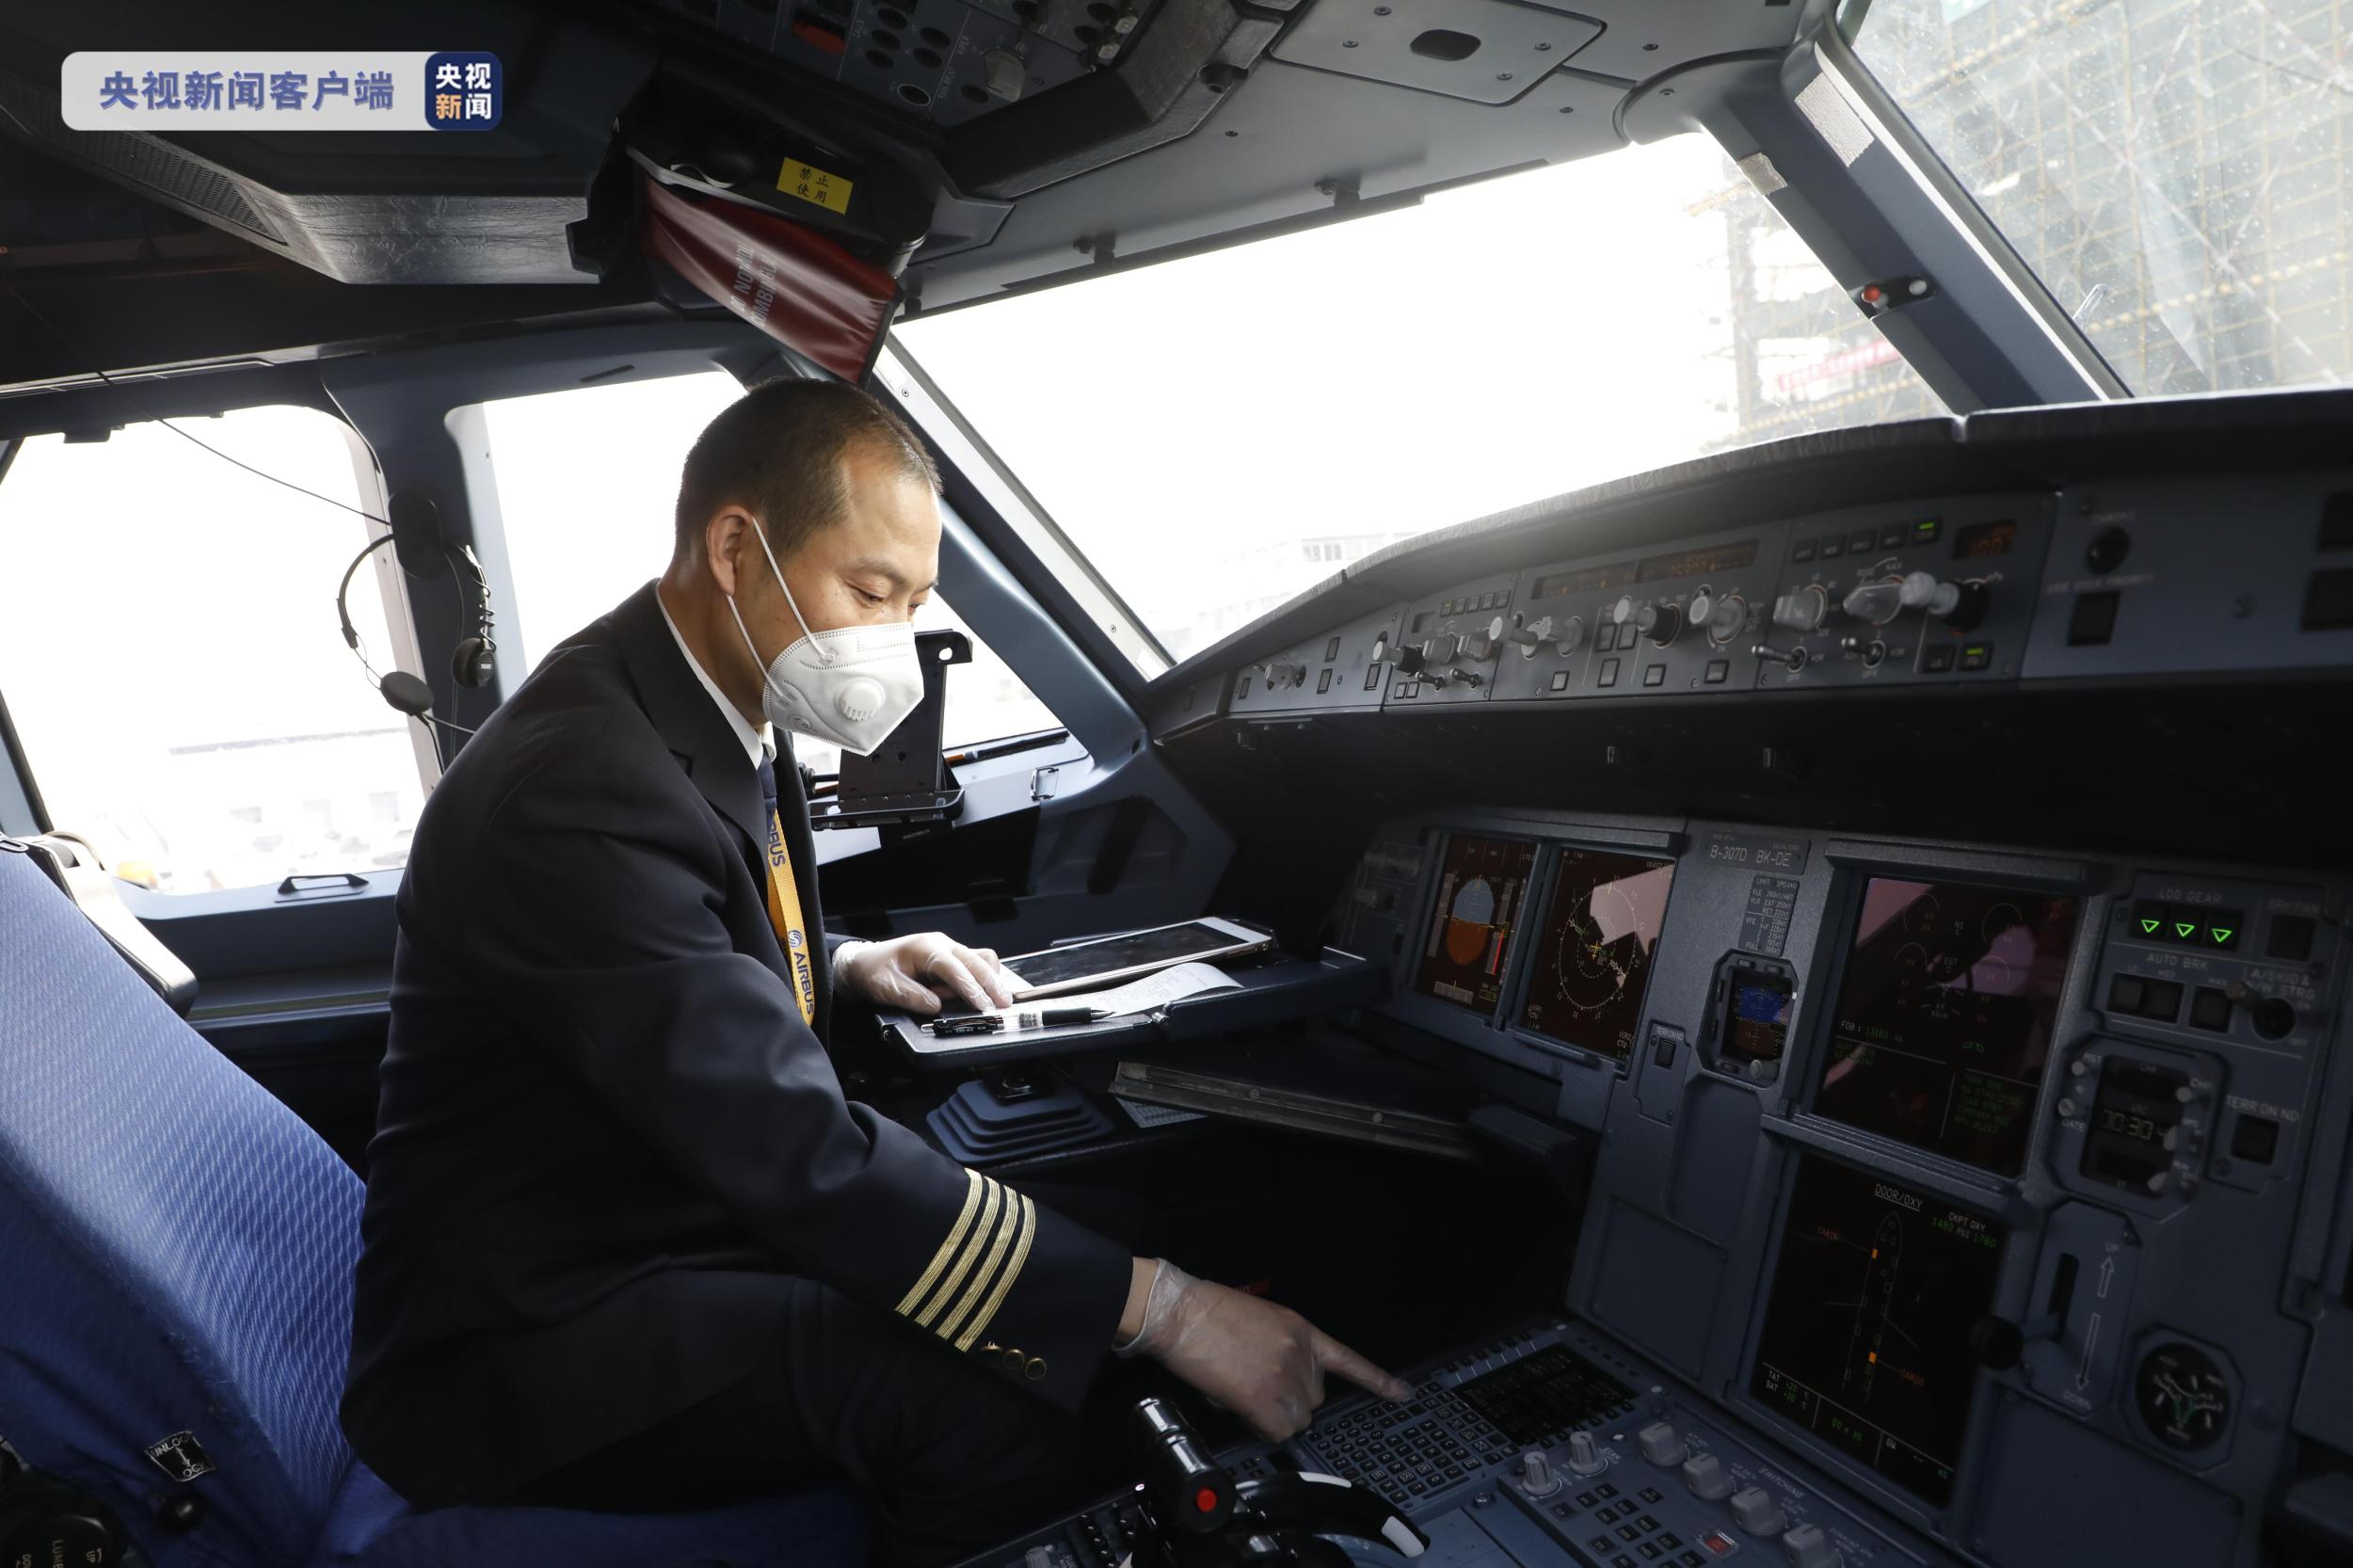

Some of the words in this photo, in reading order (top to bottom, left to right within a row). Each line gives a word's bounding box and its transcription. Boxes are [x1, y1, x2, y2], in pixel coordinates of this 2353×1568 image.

[800, 167, 829, 187] 禁止
[797, 183, 828, 203] 使用
[1755, 850, 1792, 867] BK-DE
[2160, 888, 2181, 901] LDG
[2186, 890, 2221, 904] GEAR
[2147, 952, 2178, 967] AUTO
[2183, 956, 2210, 971] BRK
[793, 952, 815, 1016] AIRBUS
[2250, 968, 2299, 984] A/SKID
[2281, 984, 2315, 1000] STRG
[2083, 1052, 2102, 1064] RST
[2226, 1094, 2257, 1111] TERR
[2262, 1101, 2279, 1116] ON
[2281, 1108, 2301, 1123] ND
[1874, 1183, 1924, 1209] DOOR/OXY
[1969, 1220, 1986, 1232] OXY
[150, 1434, 191, 1459] UNLOC
[1758, 1466, 1805, 1498] SWITCHING
[86, 1549, 96, 1564] UP
